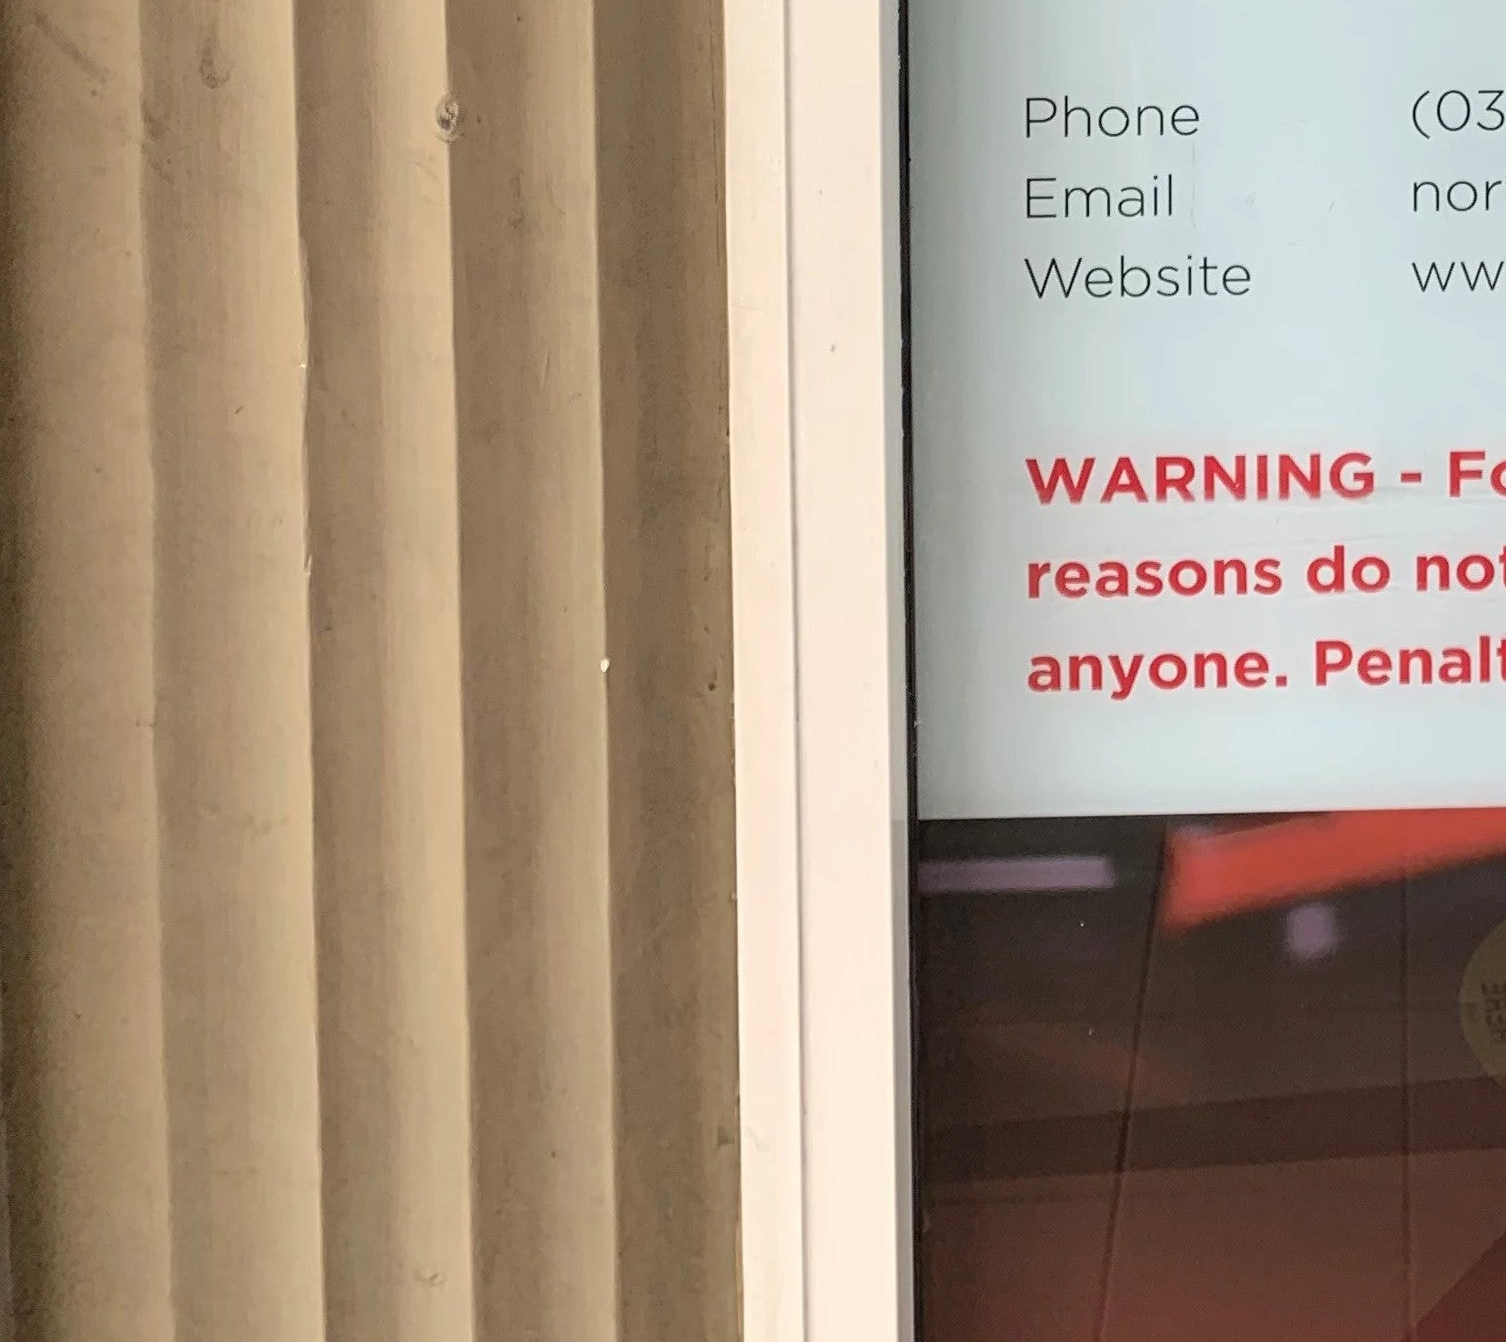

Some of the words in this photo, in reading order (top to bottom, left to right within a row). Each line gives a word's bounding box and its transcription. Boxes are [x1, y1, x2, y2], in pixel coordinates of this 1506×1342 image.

[1026, 95, 1199, 138] Phone
[1027, 174, 1172, 218] Email
[1024, 255, 1250, 299] Website
[1025, 452, 1375, 504] WARNING
[1401, 472, 1422, 483] -
[1028, 558, 1282, 598] reasons
[1307, 545, 1390, 594] do
[1028, 651, 1287, 700] anyone.
